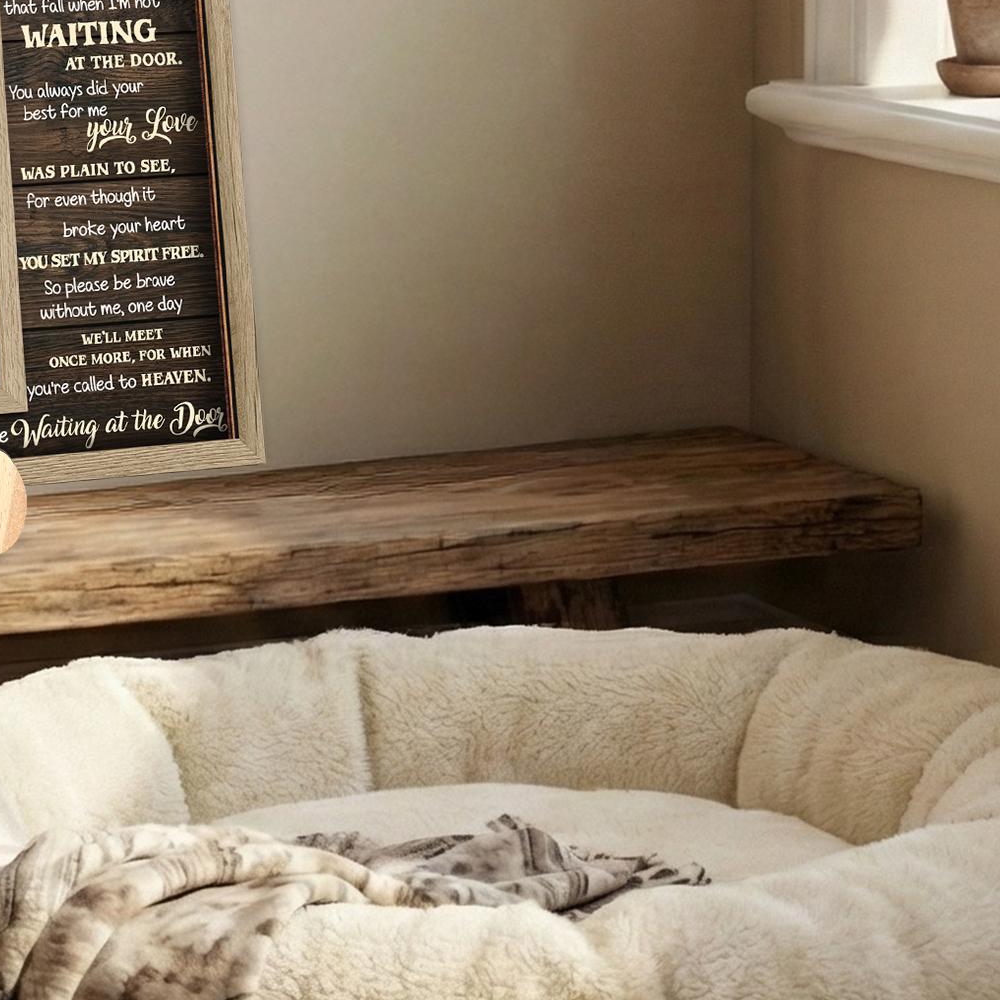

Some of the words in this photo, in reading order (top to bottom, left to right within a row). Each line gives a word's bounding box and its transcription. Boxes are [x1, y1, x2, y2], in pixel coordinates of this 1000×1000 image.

[21, 19, 156, 48] WAITING
[8, 85, 33, 100] You
[37, 82, 83, 101] always
[86, 80, 109, 95] did
[112, 82, 144, 99] your
[87, 117, 137, 152] your
[141, 106, 197, 144] Love
[26, 193, 50, 208] for
[54, 195, 87, 207] even
[90, 186, 140, 207] though
[142, 186, 156, 201] it
[18, 255, 48, 270] YOU
[51, 253, 80, 268] SET
[84, 251, 107, 266] MY
[111, 247, 159, 263] SPIRIT
[161, 245, 204, 260] FREE.
[40, 302, 97, 320] without
[100, 303, 125, 316] me,
[128, 301, 154, 313] one
[157, 295, 183, 315] day
[49, 355, 87, 368] ONCE
[91, 351, 135, 365] MORE,
[139, 349, 166, 361] FOR
[169, 345, 211, 358] WHEN
[11, 414, 99, 448] Waiting
[105, 411, 128, 433] at
[131, 409, 165, 430] the
[169, 401, 227, 437] Door
